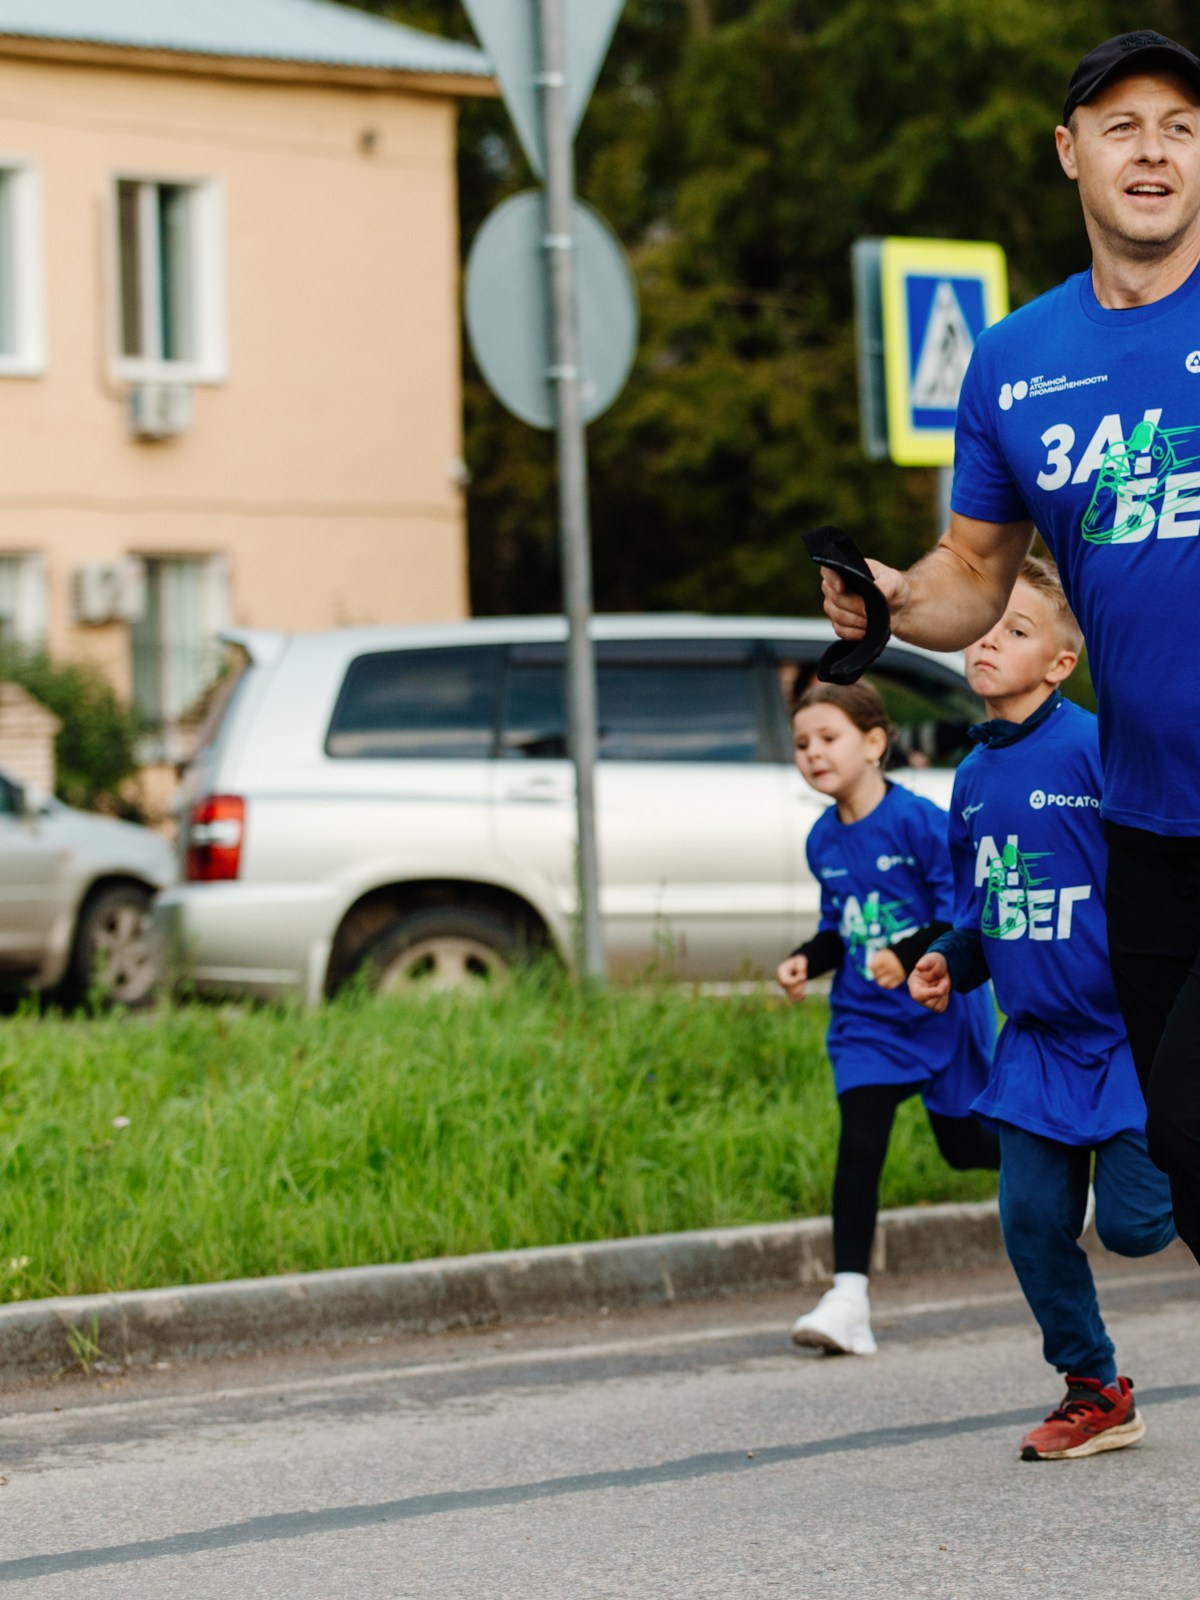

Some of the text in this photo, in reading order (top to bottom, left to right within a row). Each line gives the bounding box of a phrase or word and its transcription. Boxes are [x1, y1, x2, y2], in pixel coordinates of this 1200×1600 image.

[1029, 375, 1067, 390] АТОМНОЙ
[1029, 375, 1108, 398] ПРОМЫШЛЕННОСТИ
[1047, 794, 1101, 809] РОСАТО
[998, 885, 1092, 941] БЕГ
